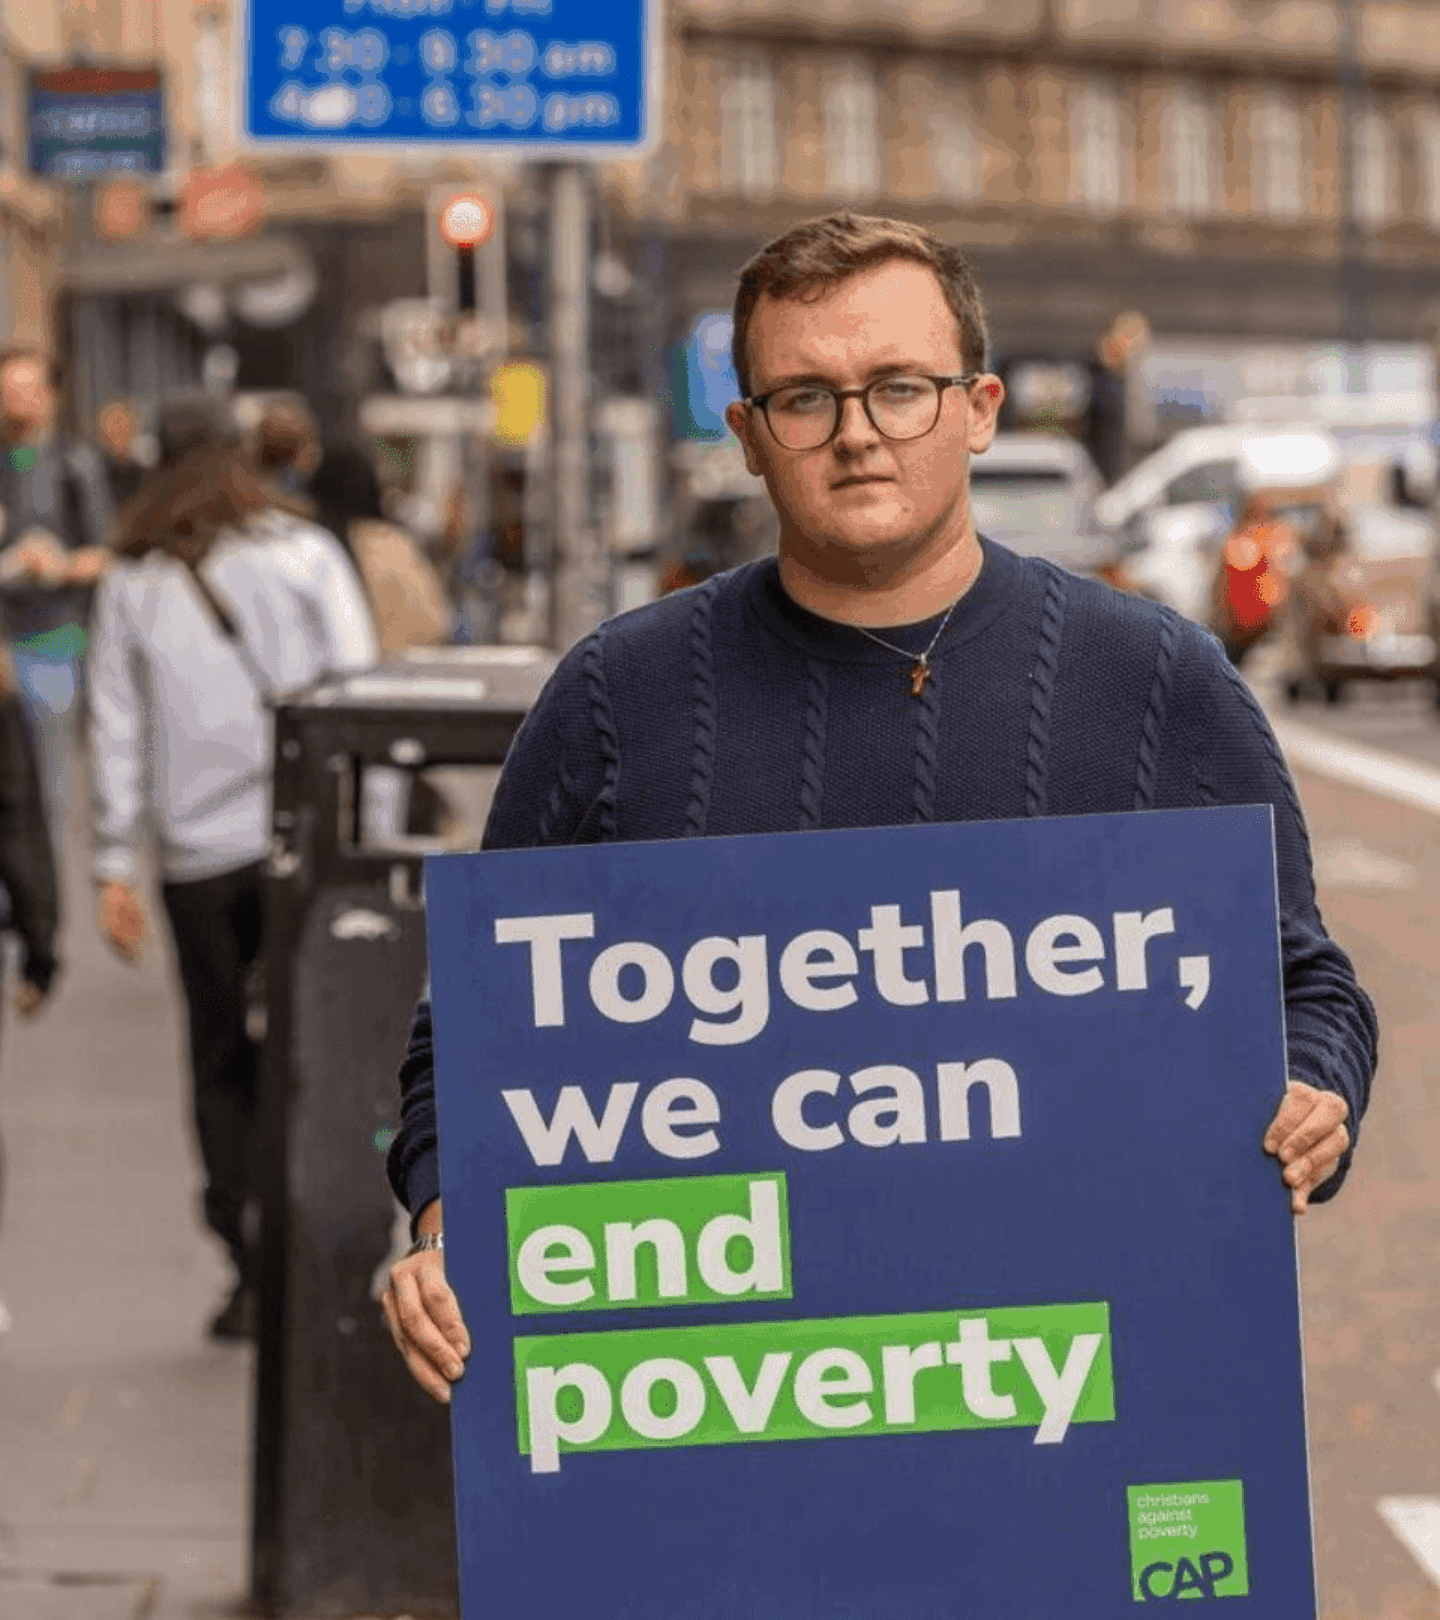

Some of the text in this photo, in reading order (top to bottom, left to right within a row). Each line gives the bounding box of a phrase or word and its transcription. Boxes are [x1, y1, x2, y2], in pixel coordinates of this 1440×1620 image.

[542, 40, 614, 77] am
[542, 92, 619, 132] pm
[495, 890, 1211, 1045] Together,
[501, 1057, 1022, 1166] we can
[516, 1179, 784, 1305] end
[525, 1317, 1103, 1474] poverty
[1136, 1493, 1211, 1509] christians
[1137, 1508, 1194, 1526] against
[1137, 1524, 1199, 1540] poverty
[1138, 1551, 1234, 1602] CAP
